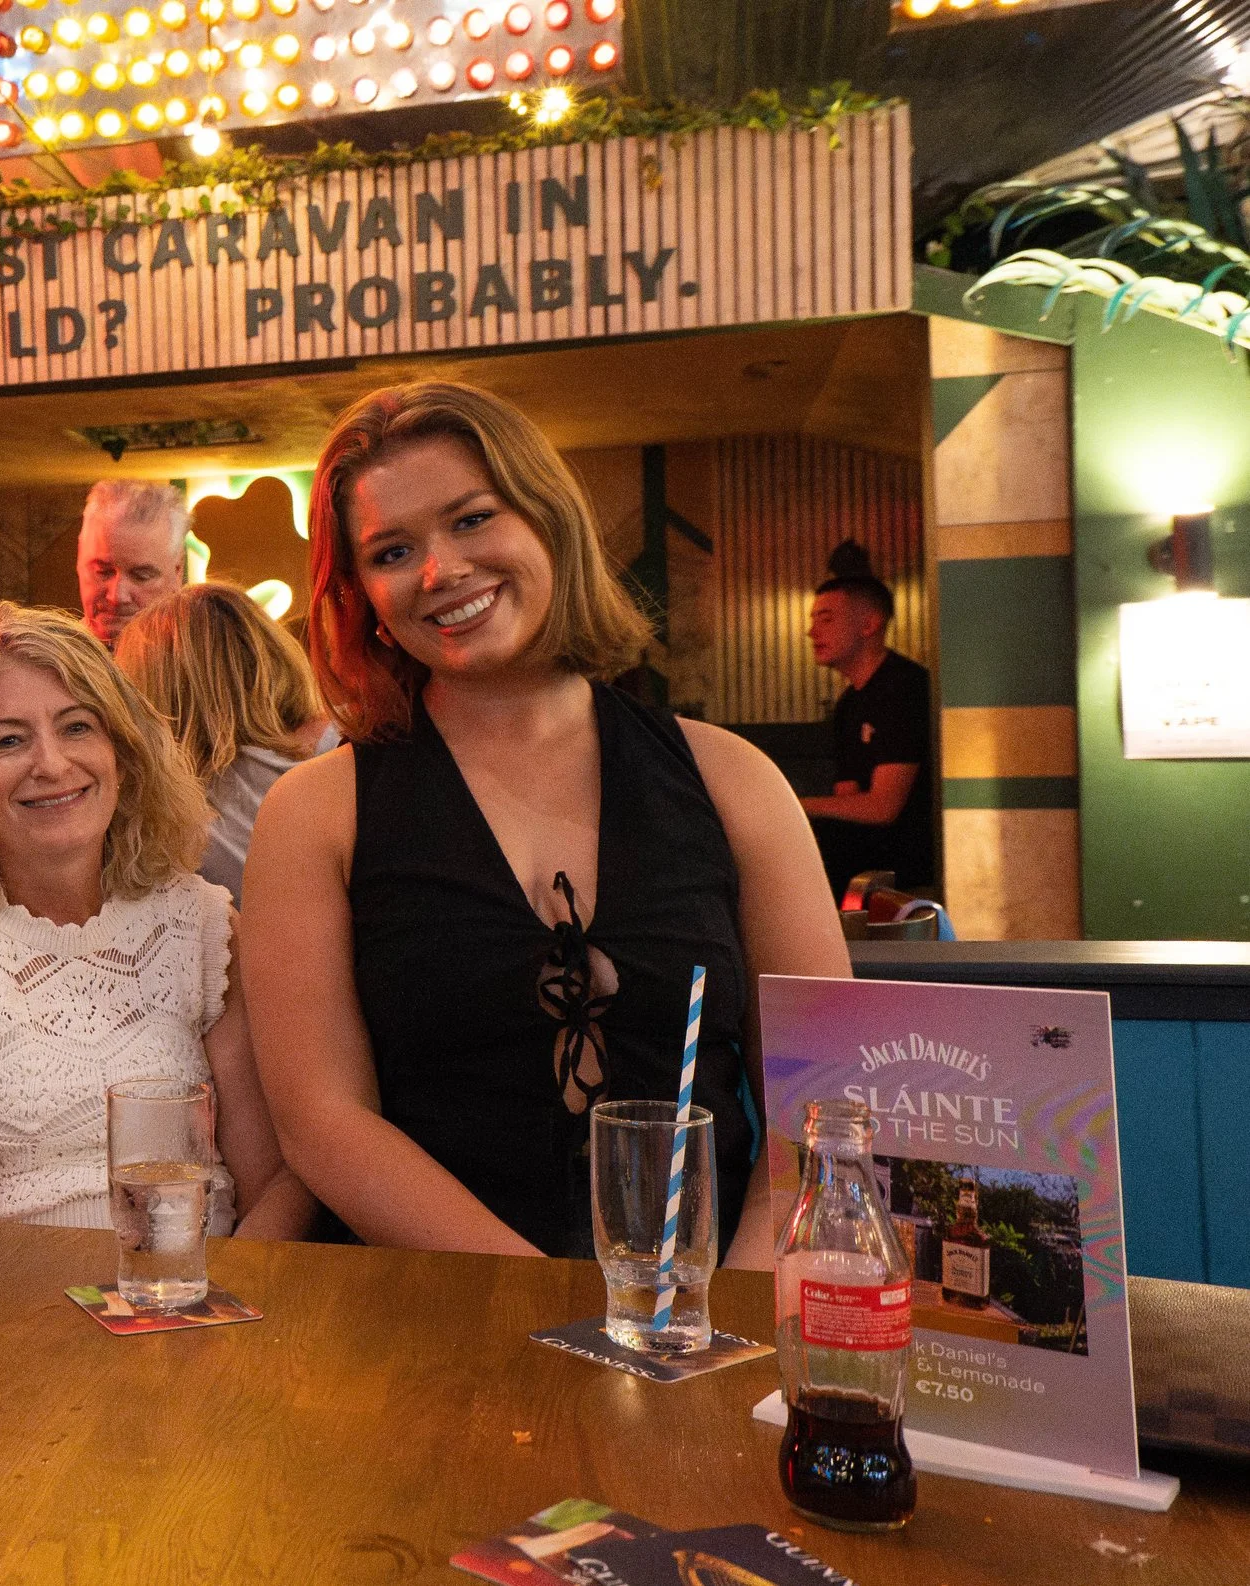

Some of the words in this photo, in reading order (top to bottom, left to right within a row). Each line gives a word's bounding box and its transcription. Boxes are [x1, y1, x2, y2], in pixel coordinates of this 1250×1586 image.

[103, 188, 464, 275] CARAVAN
[506, 174, 588, 235] IN
[246, 248, 699, 338] PROBABLY.
[859, 1039, 908, 1073] JACK
[909, 1033, 992, 1081] DANIEL'S
[844, 1084, 1017, 1126] SLÁINTE
[888, 1118, 948, 1143] THE
[954, 1124, 1019, 1150] SUN
[541, 1338, 656, 1379] GUINNESS
[917, 1357, 932, 1372] &
[938, 1362, 1046, 1394] Lemonade
[931, 1342, 1007, 1369] Daniel's
[915, 1379, 974, 1402] €7.50
